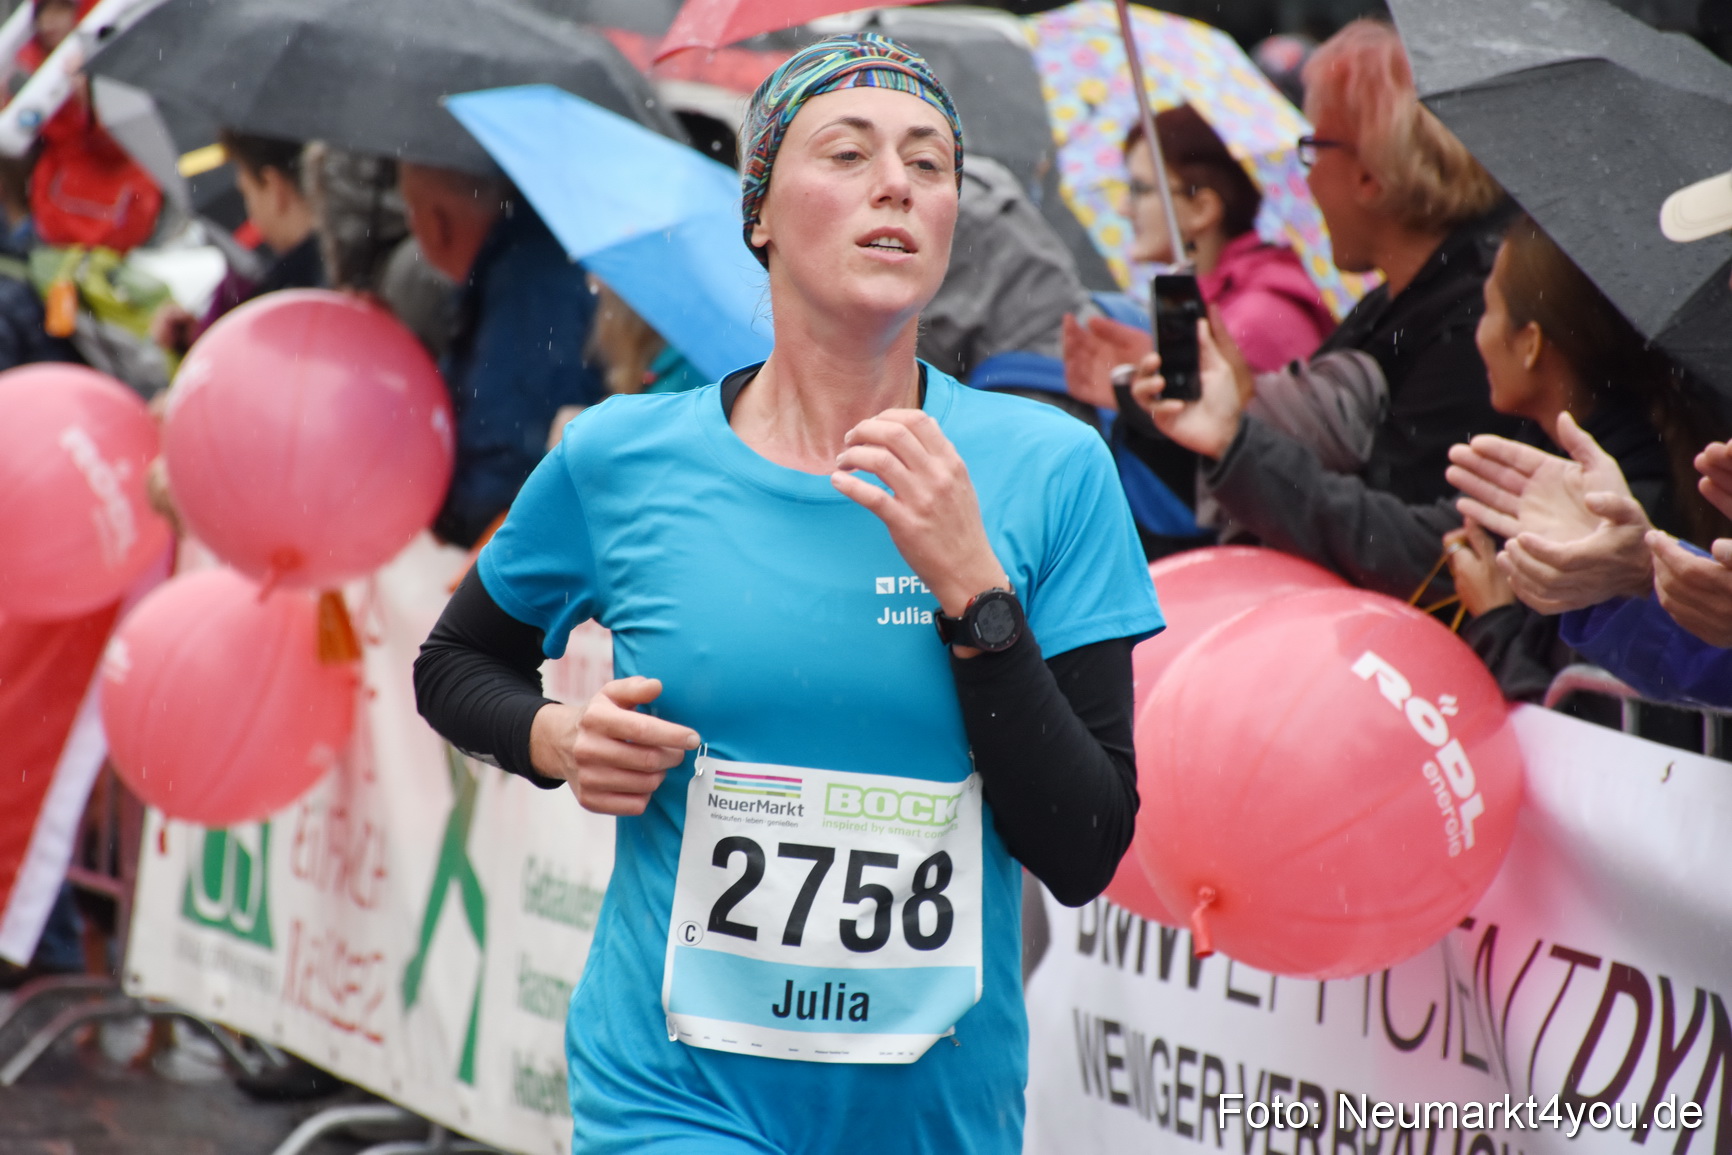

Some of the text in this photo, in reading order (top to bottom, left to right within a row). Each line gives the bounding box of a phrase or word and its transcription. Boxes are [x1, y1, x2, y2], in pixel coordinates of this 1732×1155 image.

[877, 607, 933, 625] Julia
[707, 793, 804, 818] NeuerMarkt
[1422, 759, 1462, 858] energie
[822, 818, 868, 832] inspired
[871, 822, 885, 836] by
[888, 825, 922, 839] smart
[707, 835, 955, 953] 2758
[684, 924, 697, 943] C
[772, 979, 871, 1023] Julia
